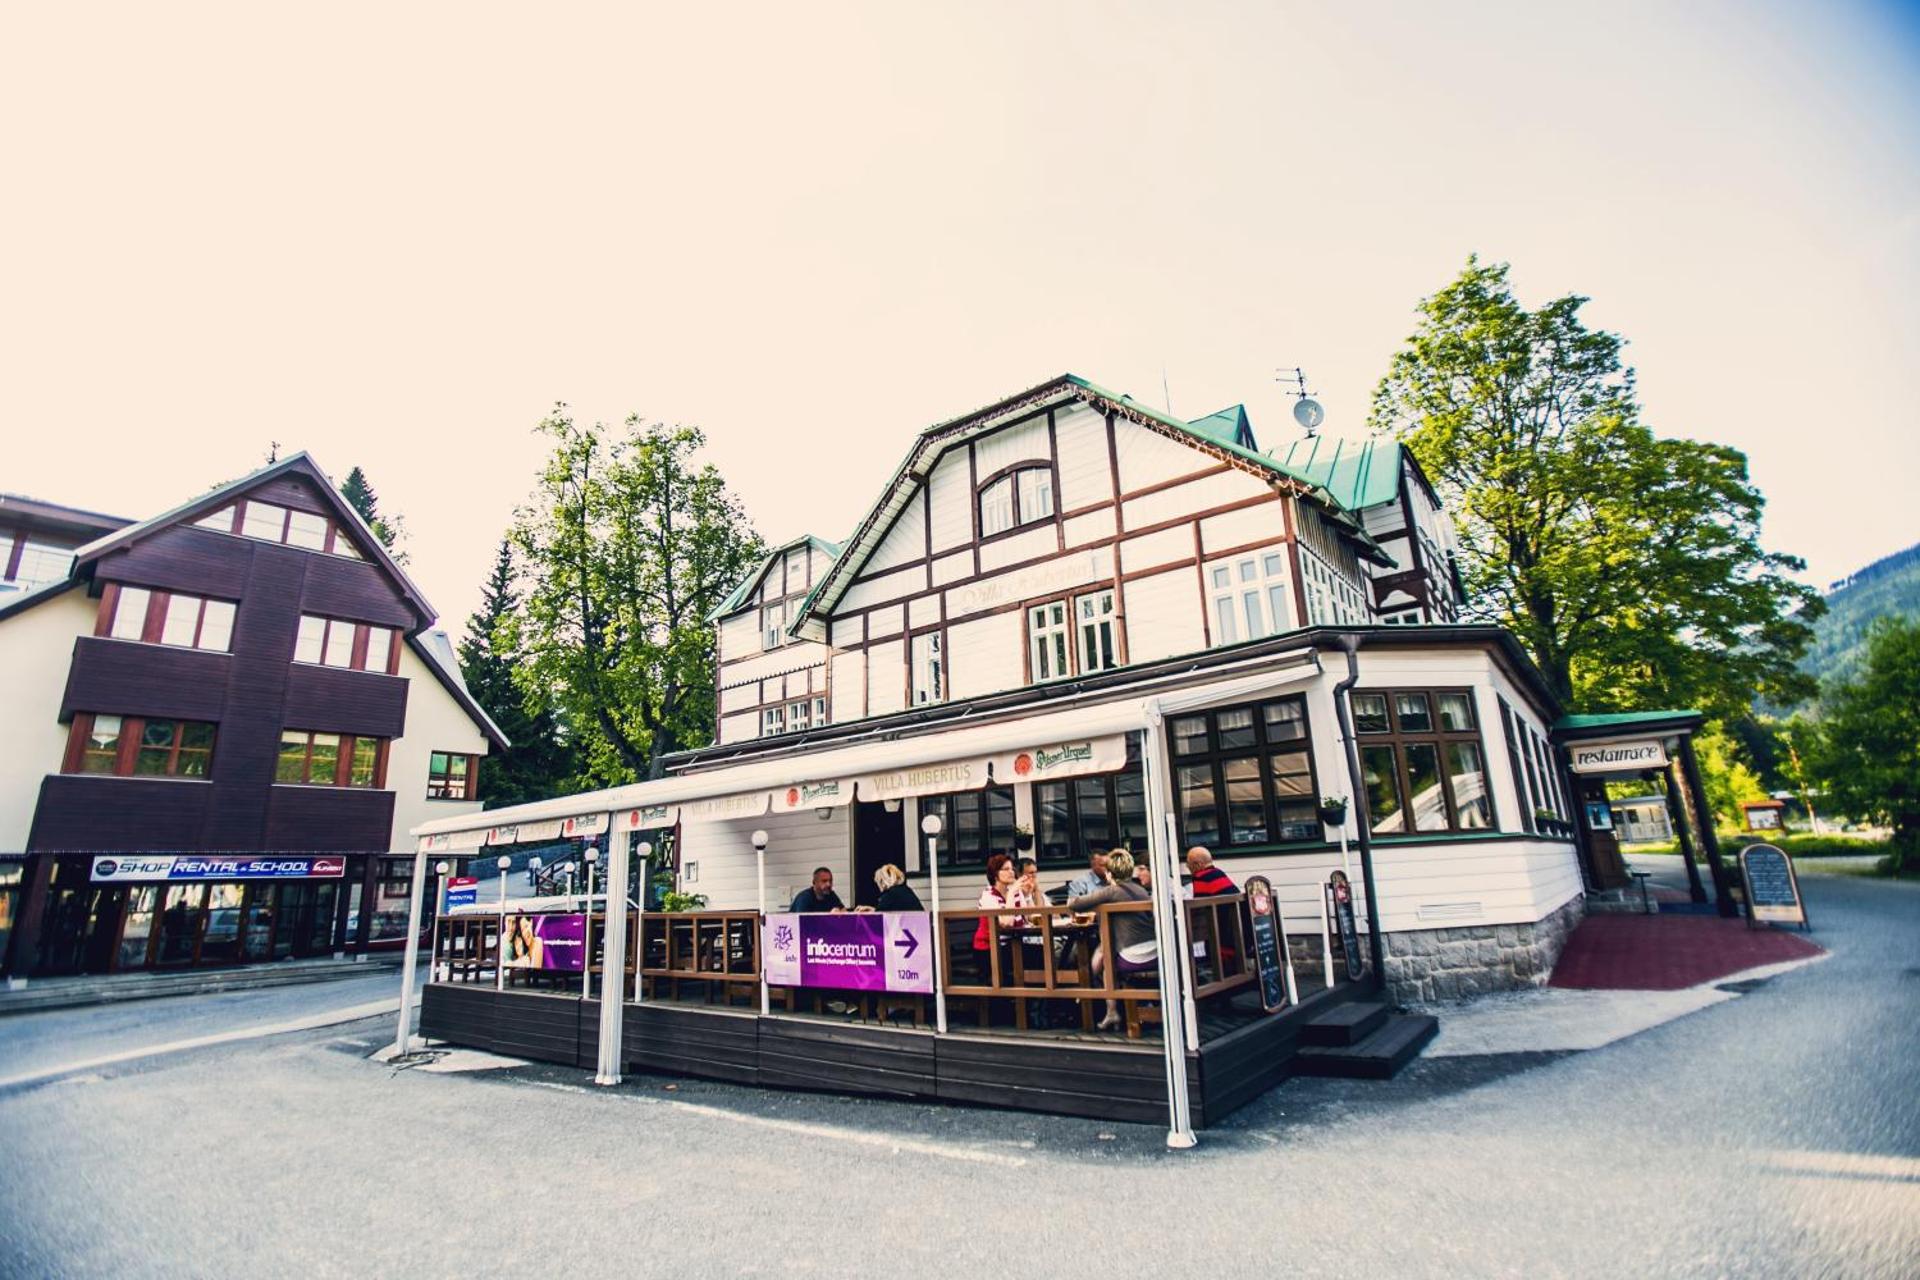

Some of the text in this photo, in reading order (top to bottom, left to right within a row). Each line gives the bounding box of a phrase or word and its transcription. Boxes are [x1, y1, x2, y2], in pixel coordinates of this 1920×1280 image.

[1036, 743, 1092, 769] Pilsner Urquell
[1578, 746, 1658, 765] restaurace
[873, 765, 971, 792] VILLA HUBERTUS
[118, 862, 170, 873] SHOP
[173, 861, 238, 873] RENTAL
[249, 861, 309, 872] SCHOOL
[807, 938, 876, 957] infocentrum
[898, 970, 919, 981] 120m
